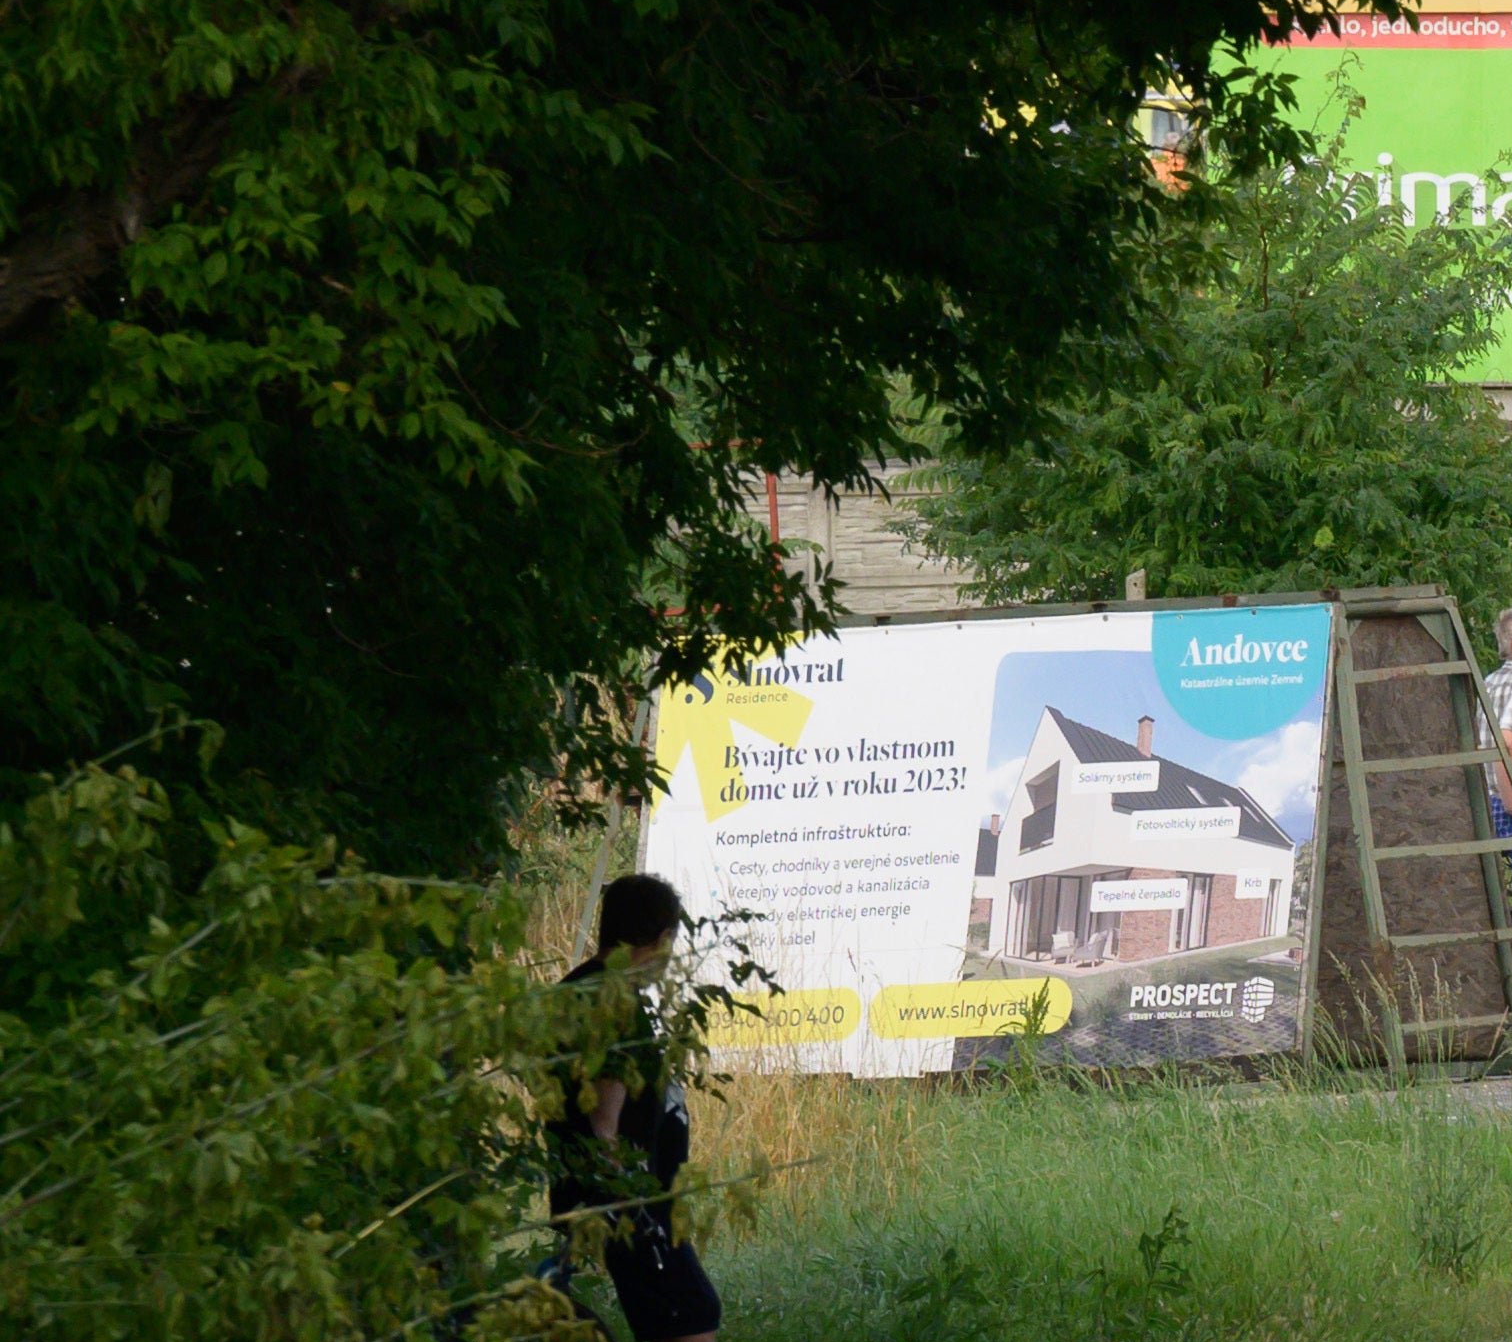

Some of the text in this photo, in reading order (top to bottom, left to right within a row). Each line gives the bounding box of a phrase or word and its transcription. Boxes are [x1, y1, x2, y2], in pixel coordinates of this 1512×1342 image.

[1179, 633, 1309, 668] Andovce
[725, 692, 789, 706] Residence
[723, 737, 956, 776] Bývajte vo vlastnom
[792, 775, 820, 800] už
[826, 779, 837, 797] v
[843, 770, 898, 796] roku
[902, 766, 968, 794] 2023!
[715, 822, 913, 848] Kompletná infraštruktúra:
[1136, 816, 1234, 831] Fotovoltický systém
[729, 850, 961, 876] Cesty, chodníky a verejné osvetlenie
[782, 883, 843, 898] vodovod
[845, 884, 854, 894] a
[857, 876, 931, 893] kanalizácia
[786, 906, 857, 922] elektrickej
[860, 903, 912, 920] energie
[1129, 982, 1238, 1008] PROSPECT
[805, 1005, 845, 1025] 400
[898, 999, 1028, 1021] www.slnovrat
